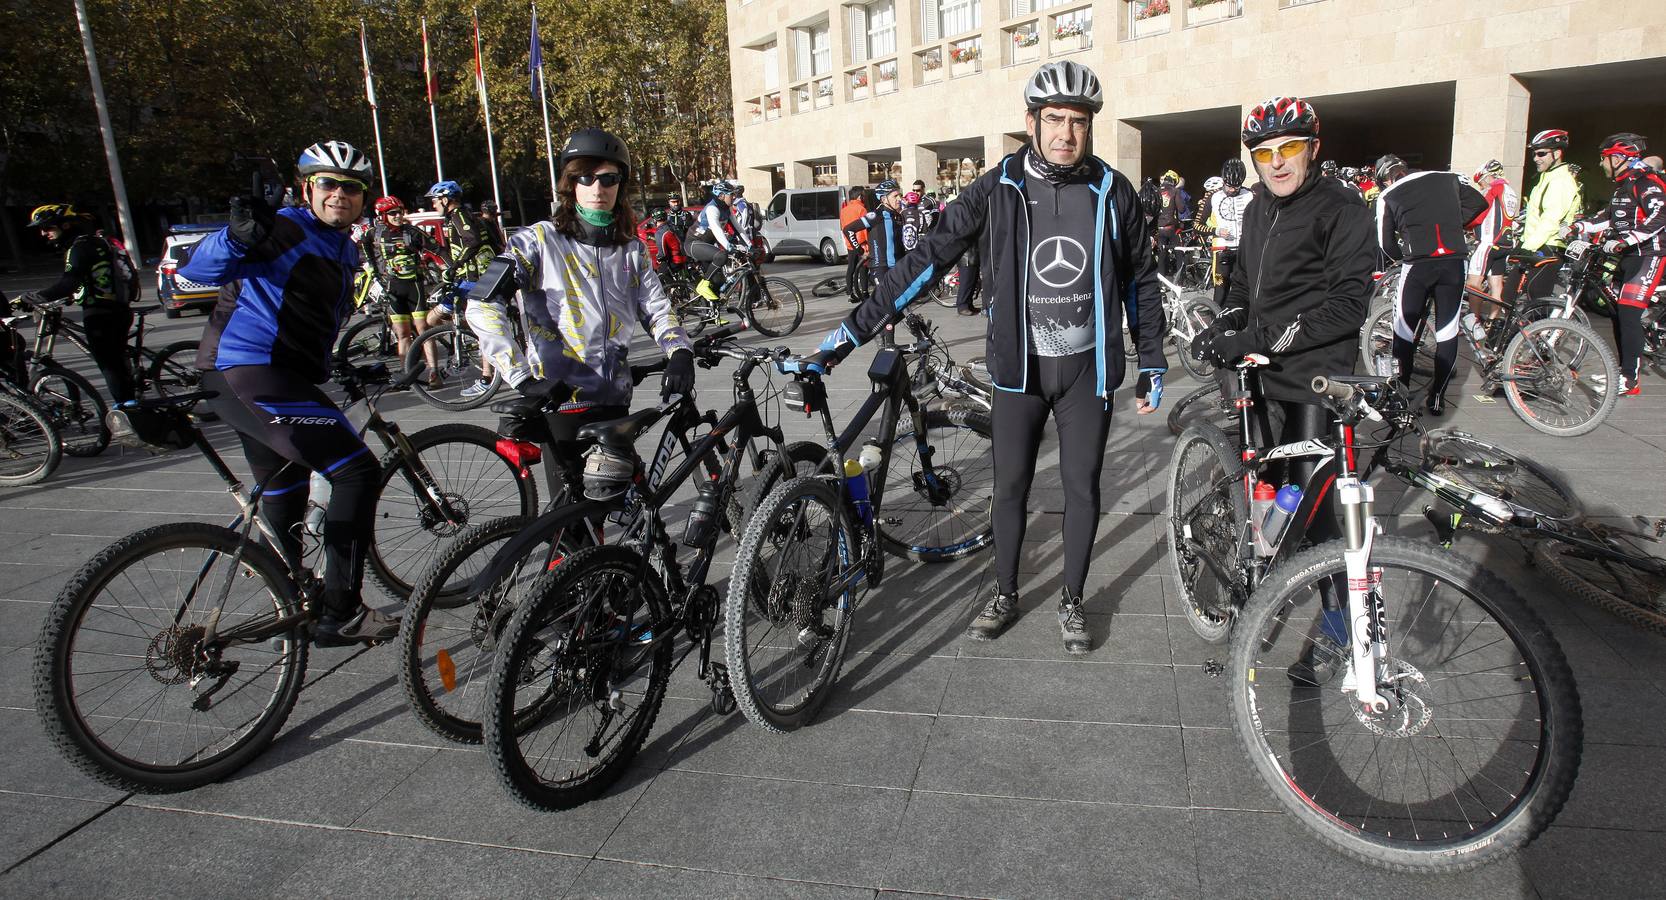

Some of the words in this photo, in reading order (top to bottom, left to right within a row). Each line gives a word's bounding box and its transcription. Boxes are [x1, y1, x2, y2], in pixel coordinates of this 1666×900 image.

[1028, 292, 1092, 304] Mercedes-Benz
[269, 416, 337, 425] X-TIGER
[648, 430, 677, 494] RIDA
[1286, 557, 1341, 586] KENDATIRE.COM
